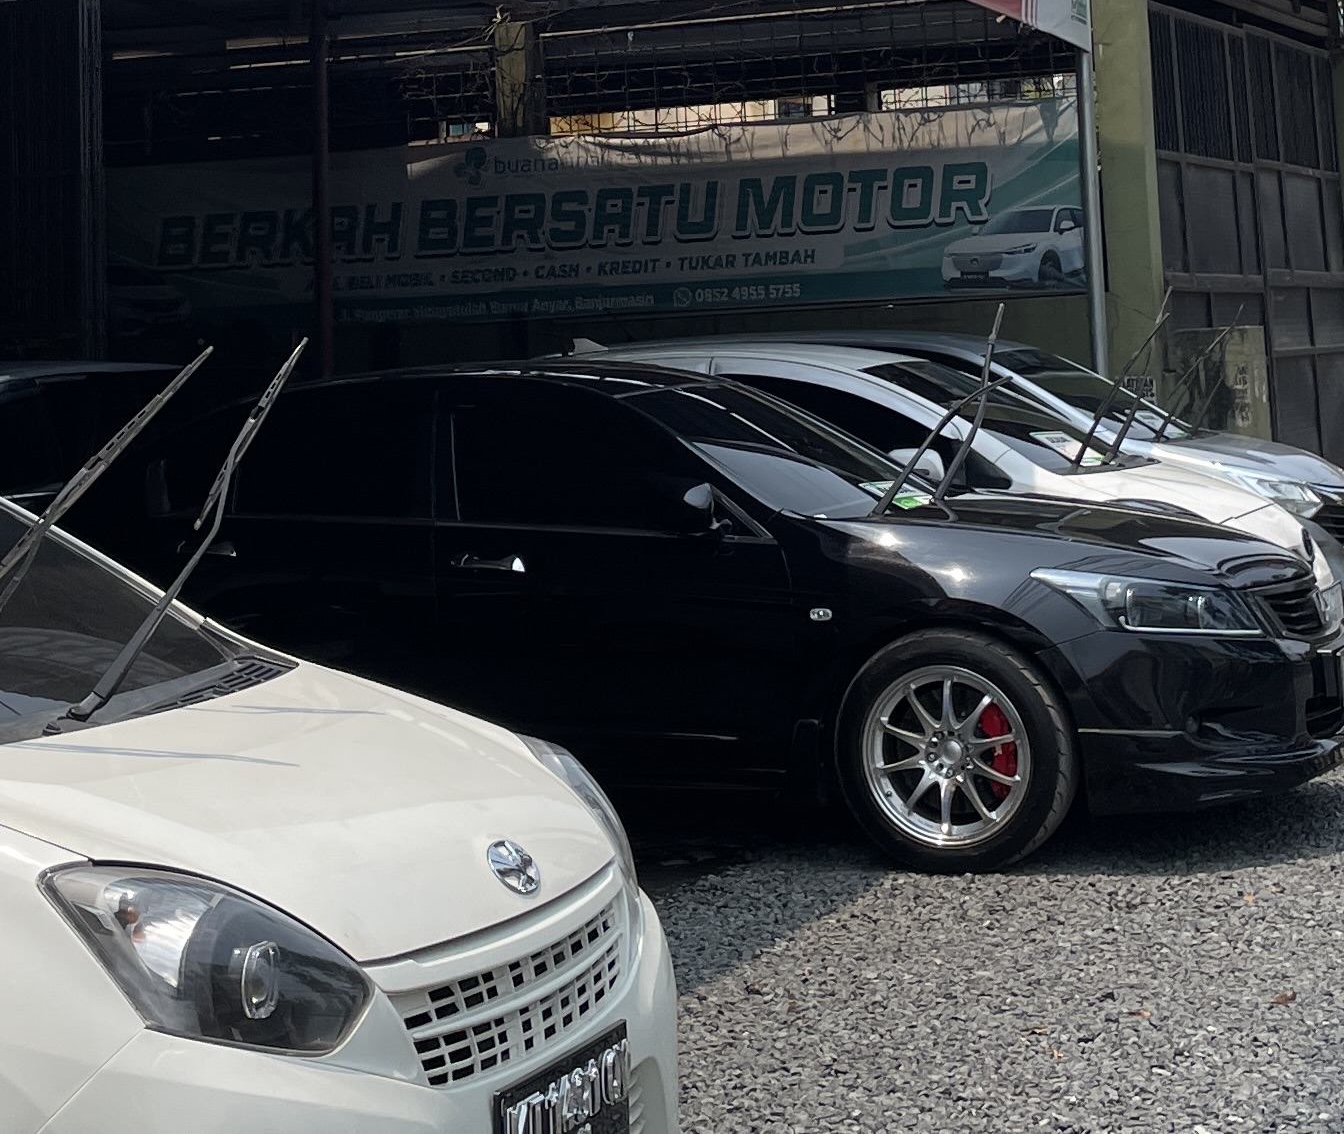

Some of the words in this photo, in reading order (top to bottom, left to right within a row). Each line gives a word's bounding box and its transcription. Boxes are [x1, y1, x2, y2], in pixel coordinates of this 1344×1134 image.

[156, 201, 406, 272] BERKAH
[414, 178, 720, 258] BERSATU
[732, 162, 993, 239] MOTOR
[451, 266, 517, 285] SECOND
[535, 263, 581, 280] CASH
[597, 258, 662, 278] KREDIT
[678, 253, 737, 272] TUKAR
[741, 248, 816, 268] TAMBAH
[769, 282, 801, 299] 5755
